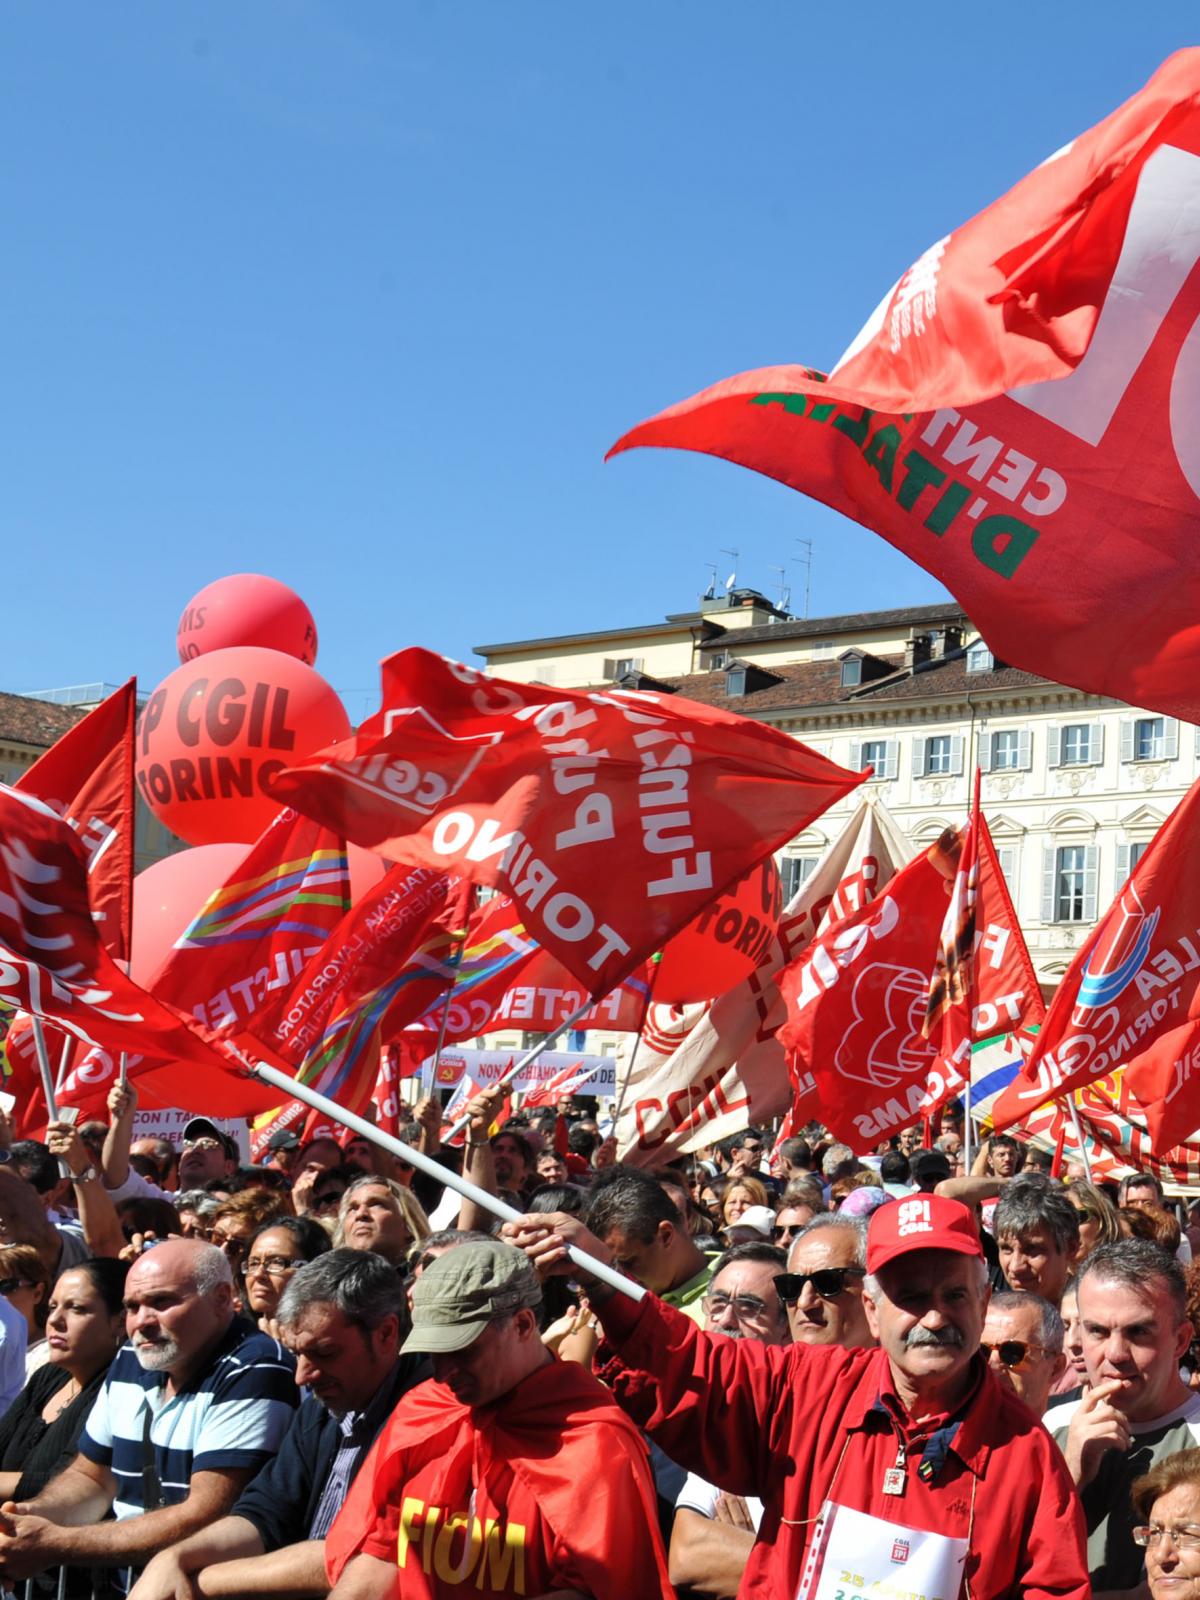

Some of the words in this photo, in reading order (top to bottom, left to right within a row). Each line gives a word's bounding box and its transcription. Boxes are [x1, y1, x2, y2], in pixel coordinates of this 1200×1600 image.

[176, 677, 296, 751] CGIL
[132, 1112, 162, 1124] CON
[165, 1112, 171, 1124] I
[898, 1199, 931, 1226] SPI
[898, 1221, 934, 1237] CGIL
[397, 1496, 526, 1596] FIOM
[840, 1570, 865, 1588] 25
